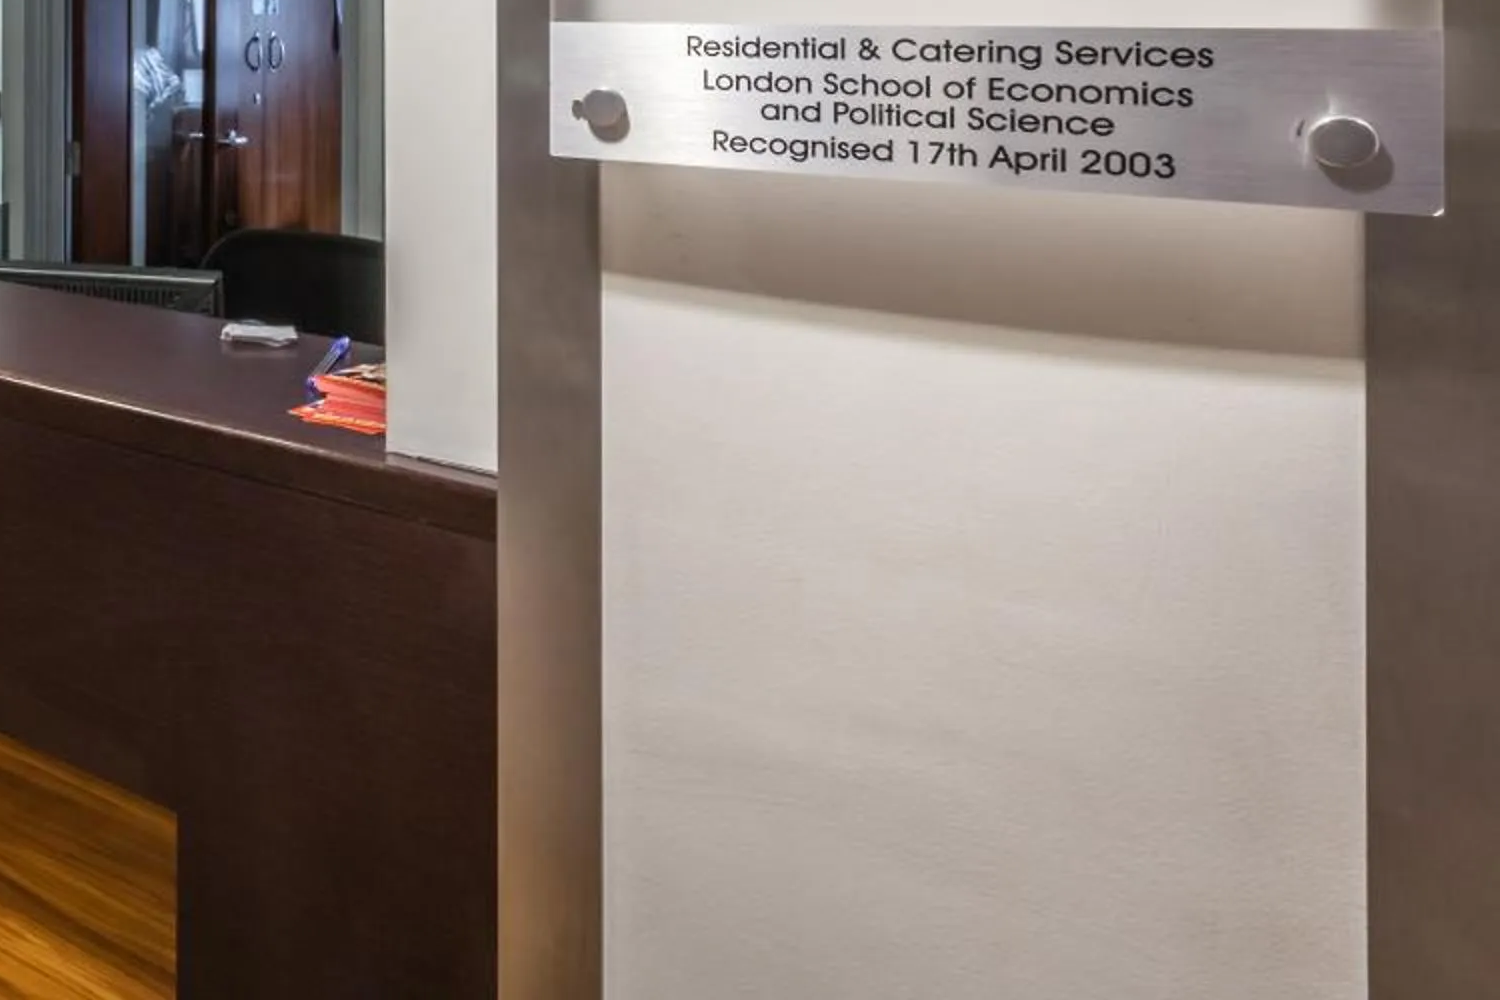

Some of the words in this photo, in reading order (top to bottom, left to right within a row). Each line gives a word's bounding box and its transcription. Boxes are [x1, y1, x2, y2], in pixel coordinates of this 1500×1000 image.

[686, 35, 847, 62] Residential
[858, 37, 881, 61] &
[891, 37, 1043, 71] Catering
[1055, 40, 1214, 69] Services
[703, 68, 813, 96] London
[823, 72, 932, 100] School
[943, 75, 977, 101] of
[988, 77, 1194, 109] Economics
[760, 100, 822, 124] and
[833, 101, 956, 131] Political
[967, 107, 1116, 138] Science
[712, 129, 895, 164] Recognised
[908, 139, 979, 168] 17th
[988, 144, 1067, 177] April
[1080, 148, 1177, 180] 2003
